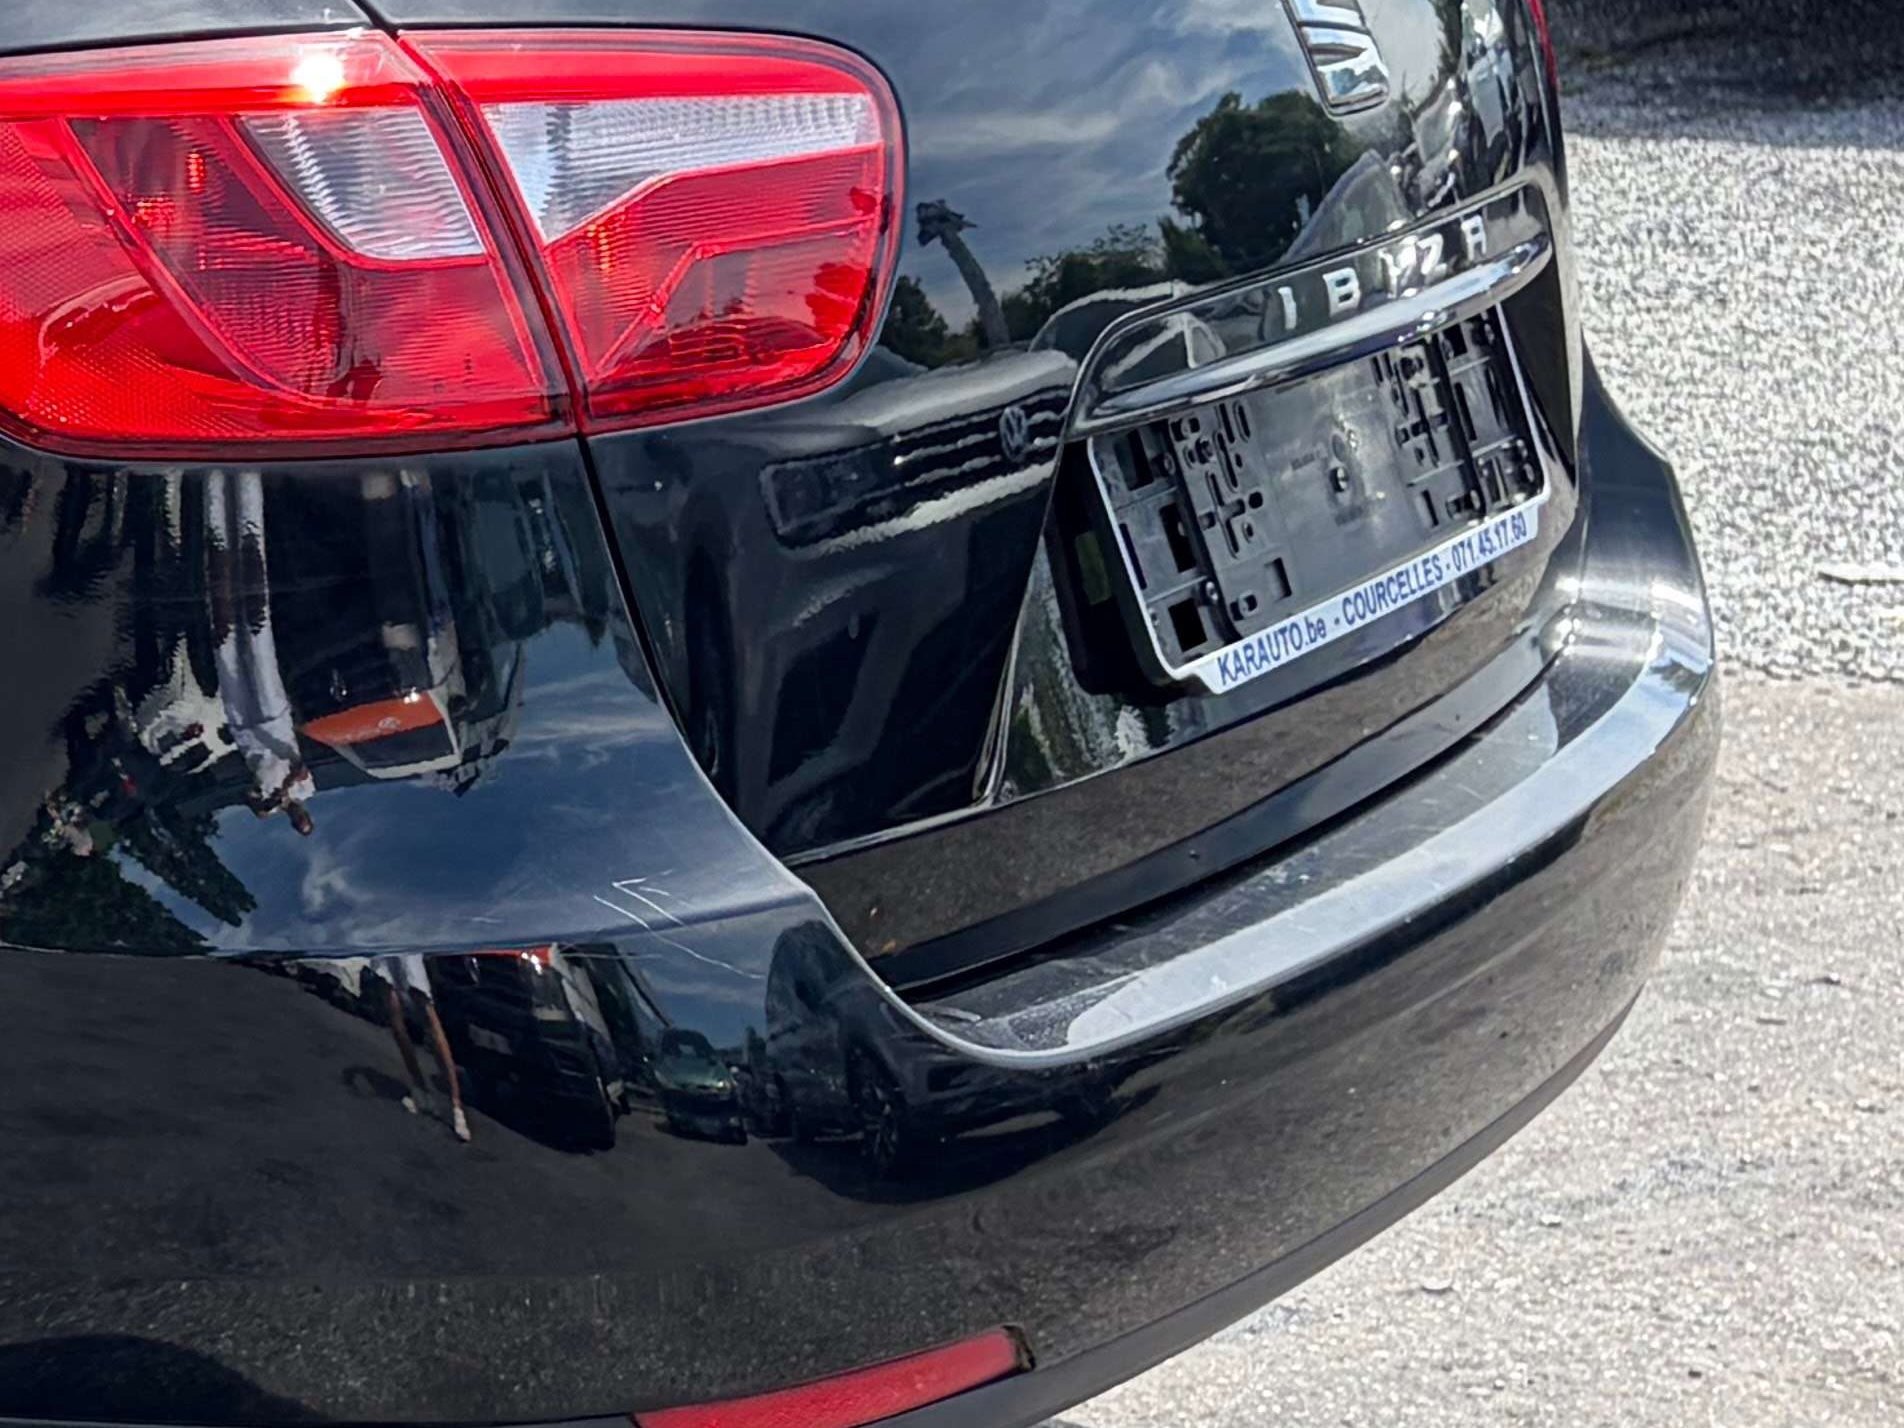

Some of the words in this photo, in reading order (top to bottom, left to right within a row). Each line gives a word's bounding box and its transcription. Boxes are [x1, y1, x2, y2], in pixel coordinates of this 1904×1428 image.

[1216, 617, 1328, 686] KARAUTO.be
[1342, 554, 1444, 627] COURCELLES
[1451, 511, 1529, 572] 071.45.17.60
